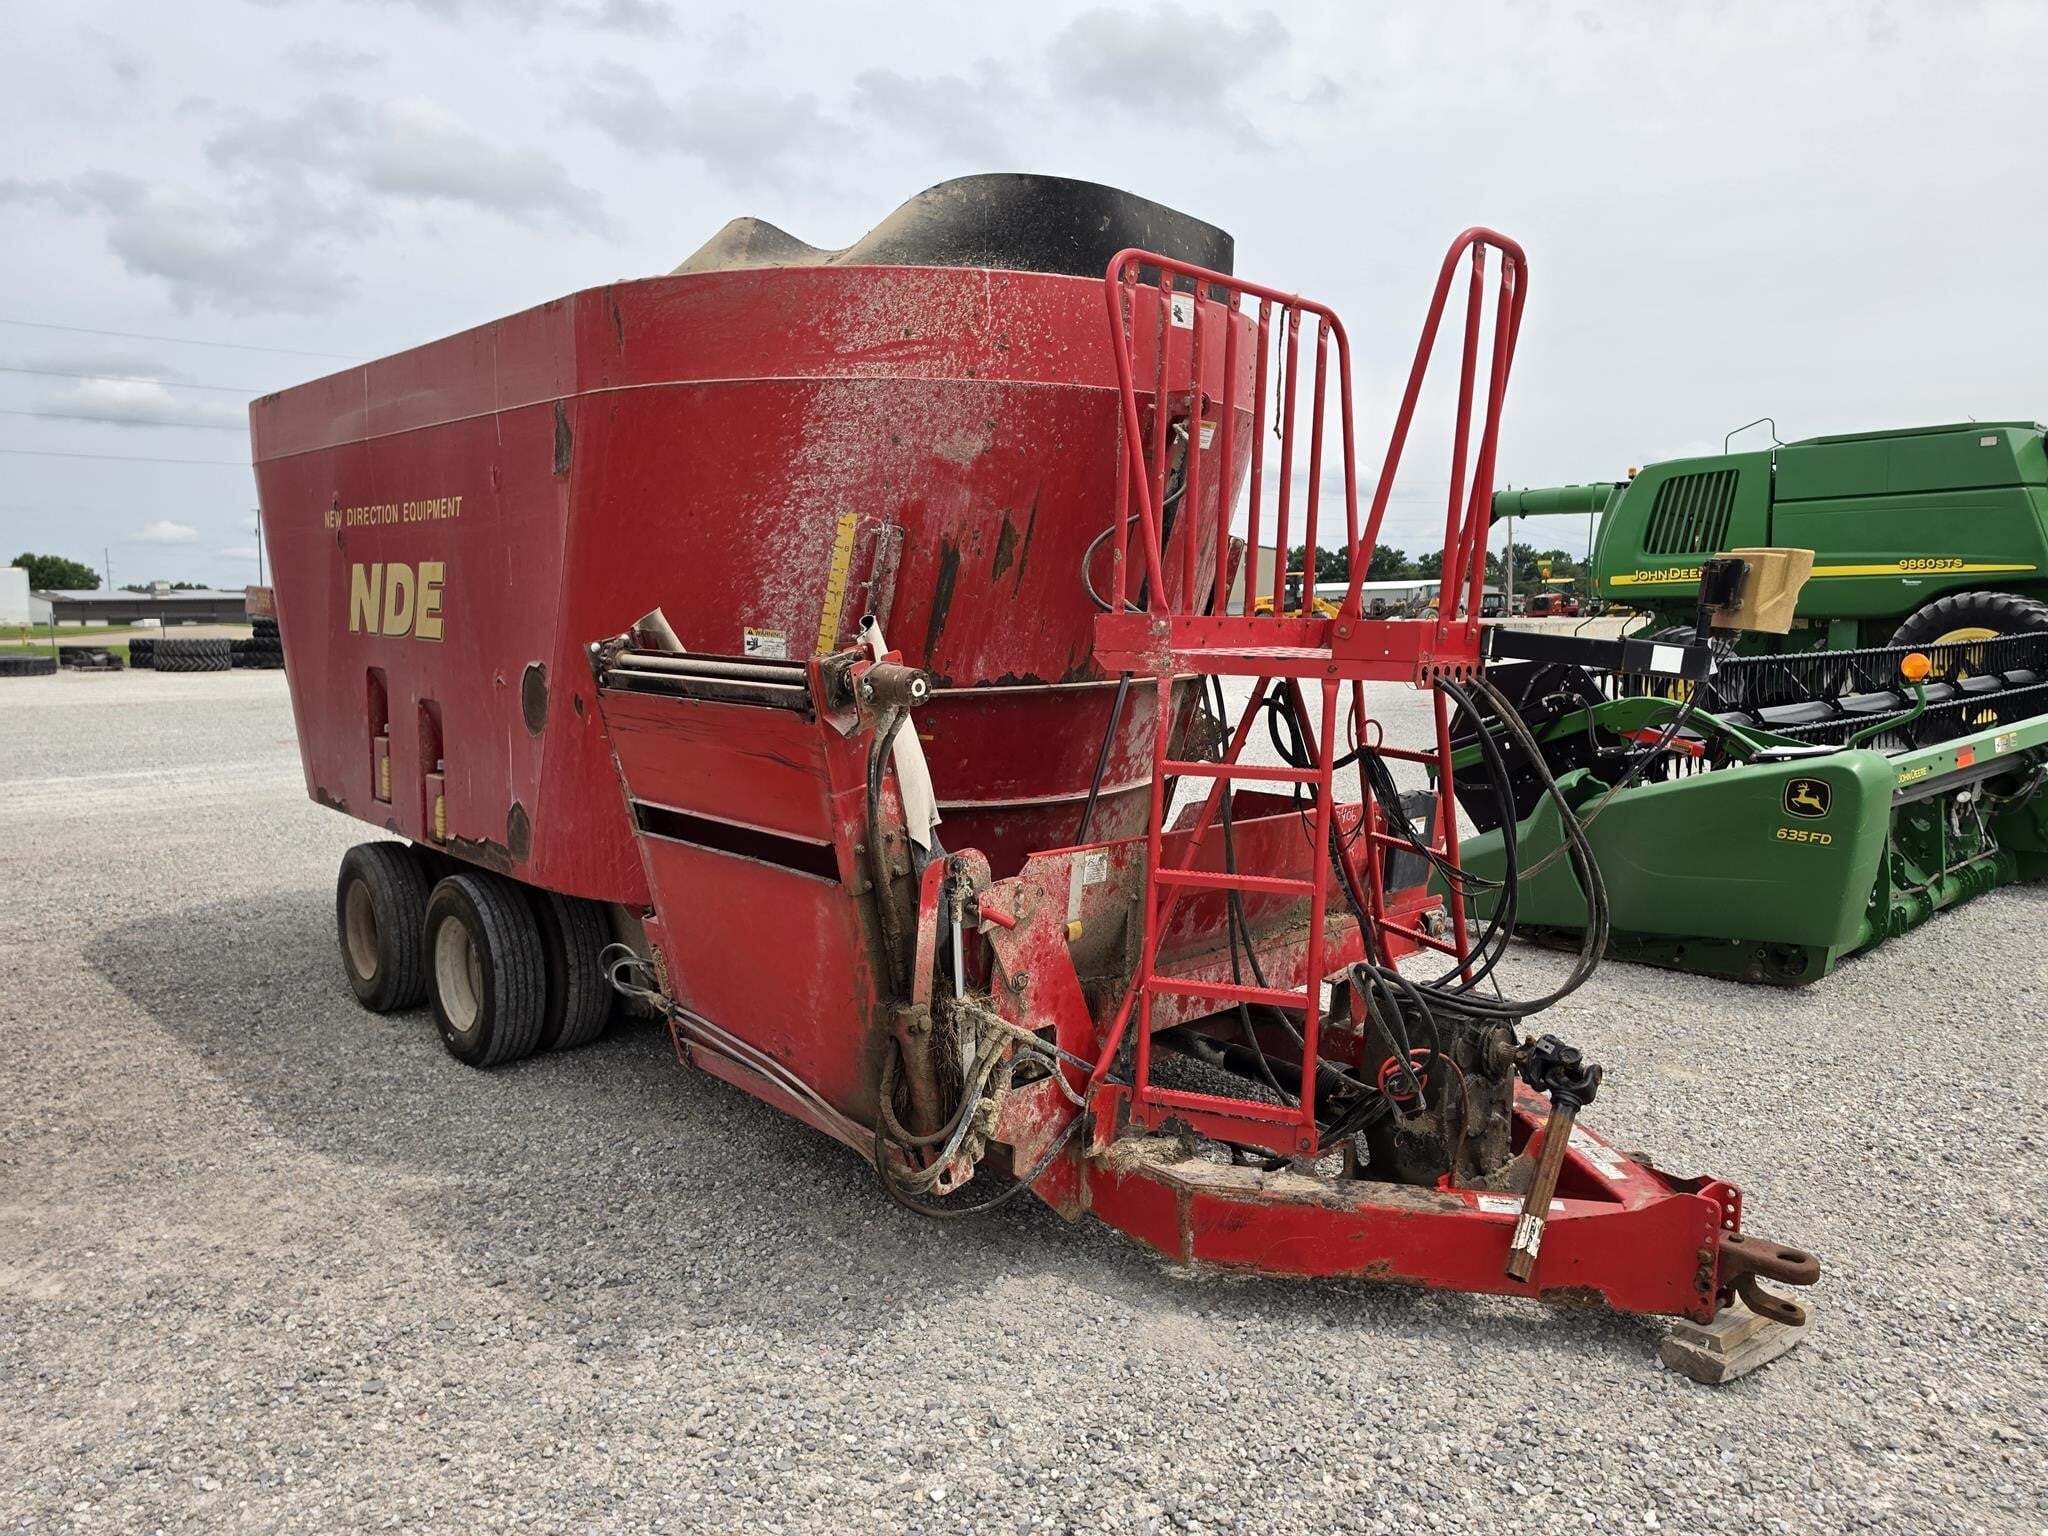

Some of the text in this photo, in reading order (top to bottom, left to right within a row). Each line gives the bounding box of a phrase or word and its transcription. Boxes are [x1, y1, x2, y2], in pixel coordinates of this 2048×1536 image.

[325, 496, 463, 529] NEW DIRECTION EQUIPMENT
[1899, 558, 1964, 570] 9860STS
[1631, 569, 1668, 582] JOHN
[349, 561, 446, 643] NDE
[754, 629, 784, 639] WARNING
[1910, 767, 1927, 780] DEERE
